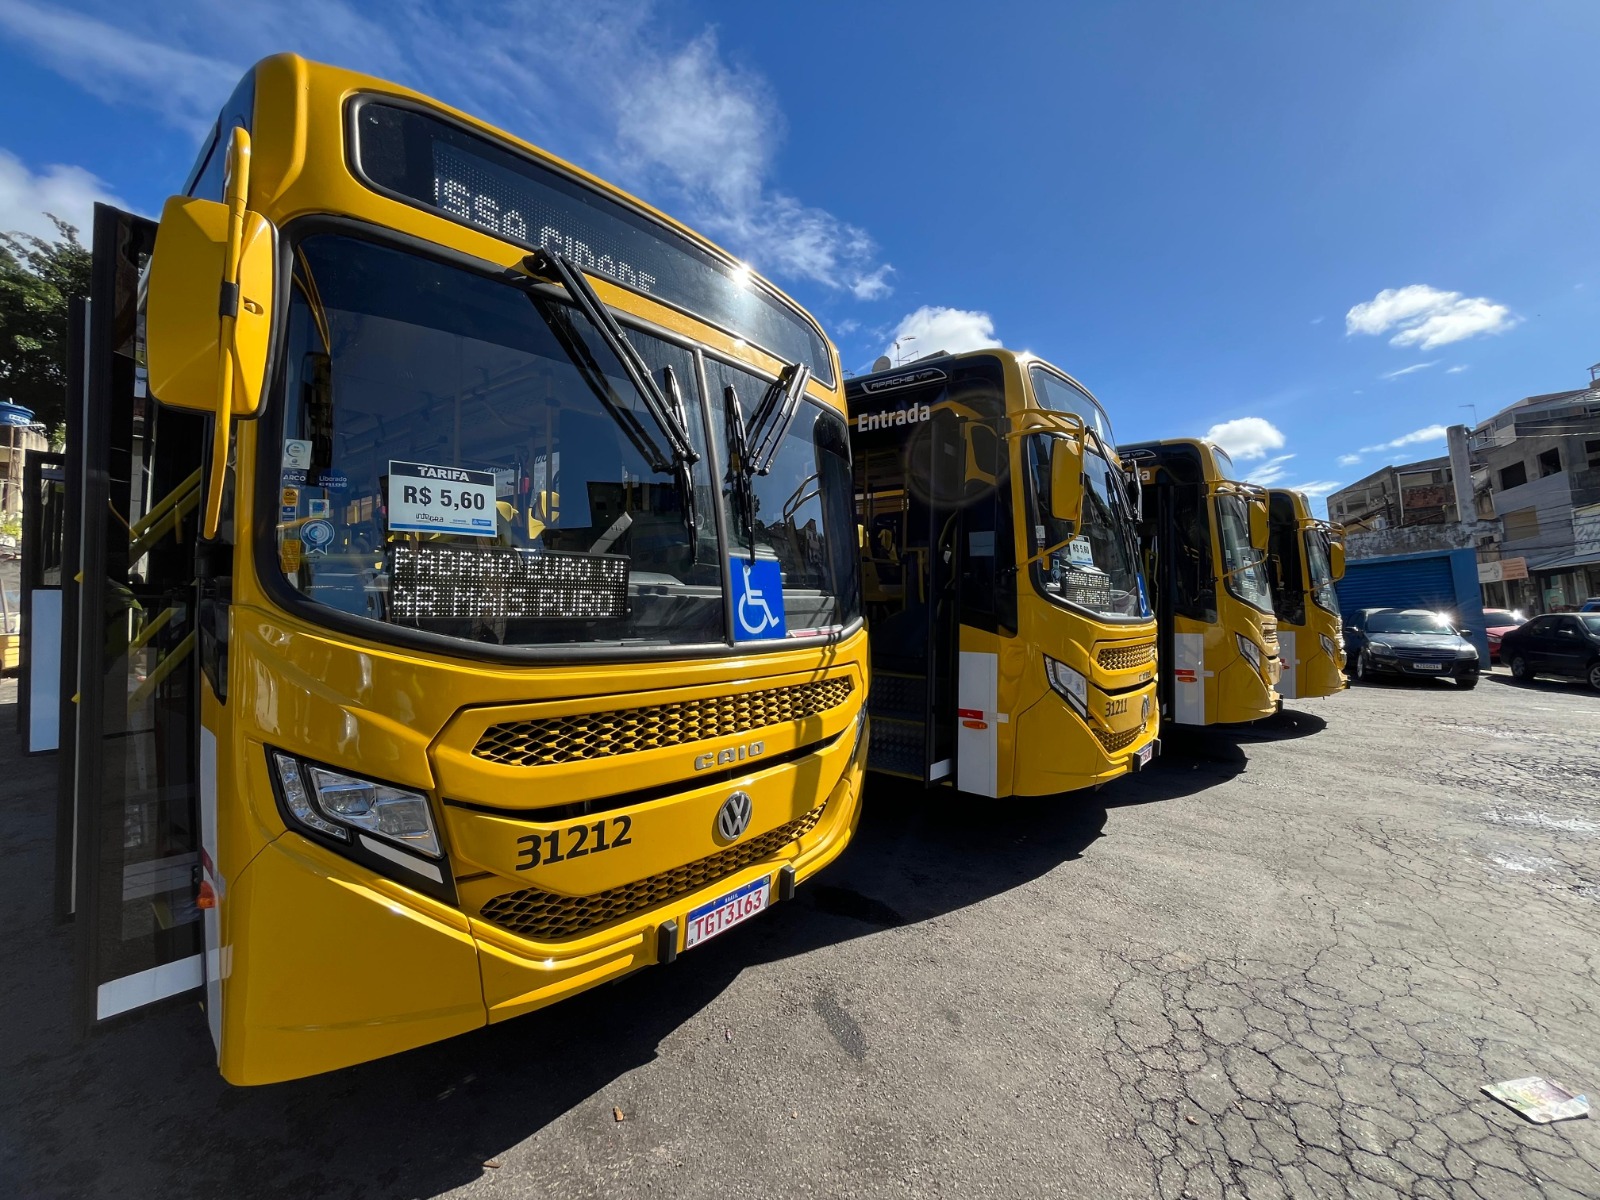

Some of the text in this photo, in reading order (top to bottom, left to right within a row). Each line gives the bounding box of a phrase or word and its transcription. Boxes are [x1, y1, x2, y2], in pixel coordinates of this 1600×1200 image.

[434, 178, 527, 241] SSA
[871, 371, 934, 389] APACHE VIP
[857, 402, 931, 433] Entrada
[417, 466, 470, 482] TARIFA
[403, 485, 485, 511] R$ 5,60
[527, 556, 591, 581] EURO
[393, 585, 613, 617] AR MAIS PURO
[1105, 698, 1128, 718] 31211
[694, 740, 765, 771] CAIO
[515, 815, 632, 871] 31212
